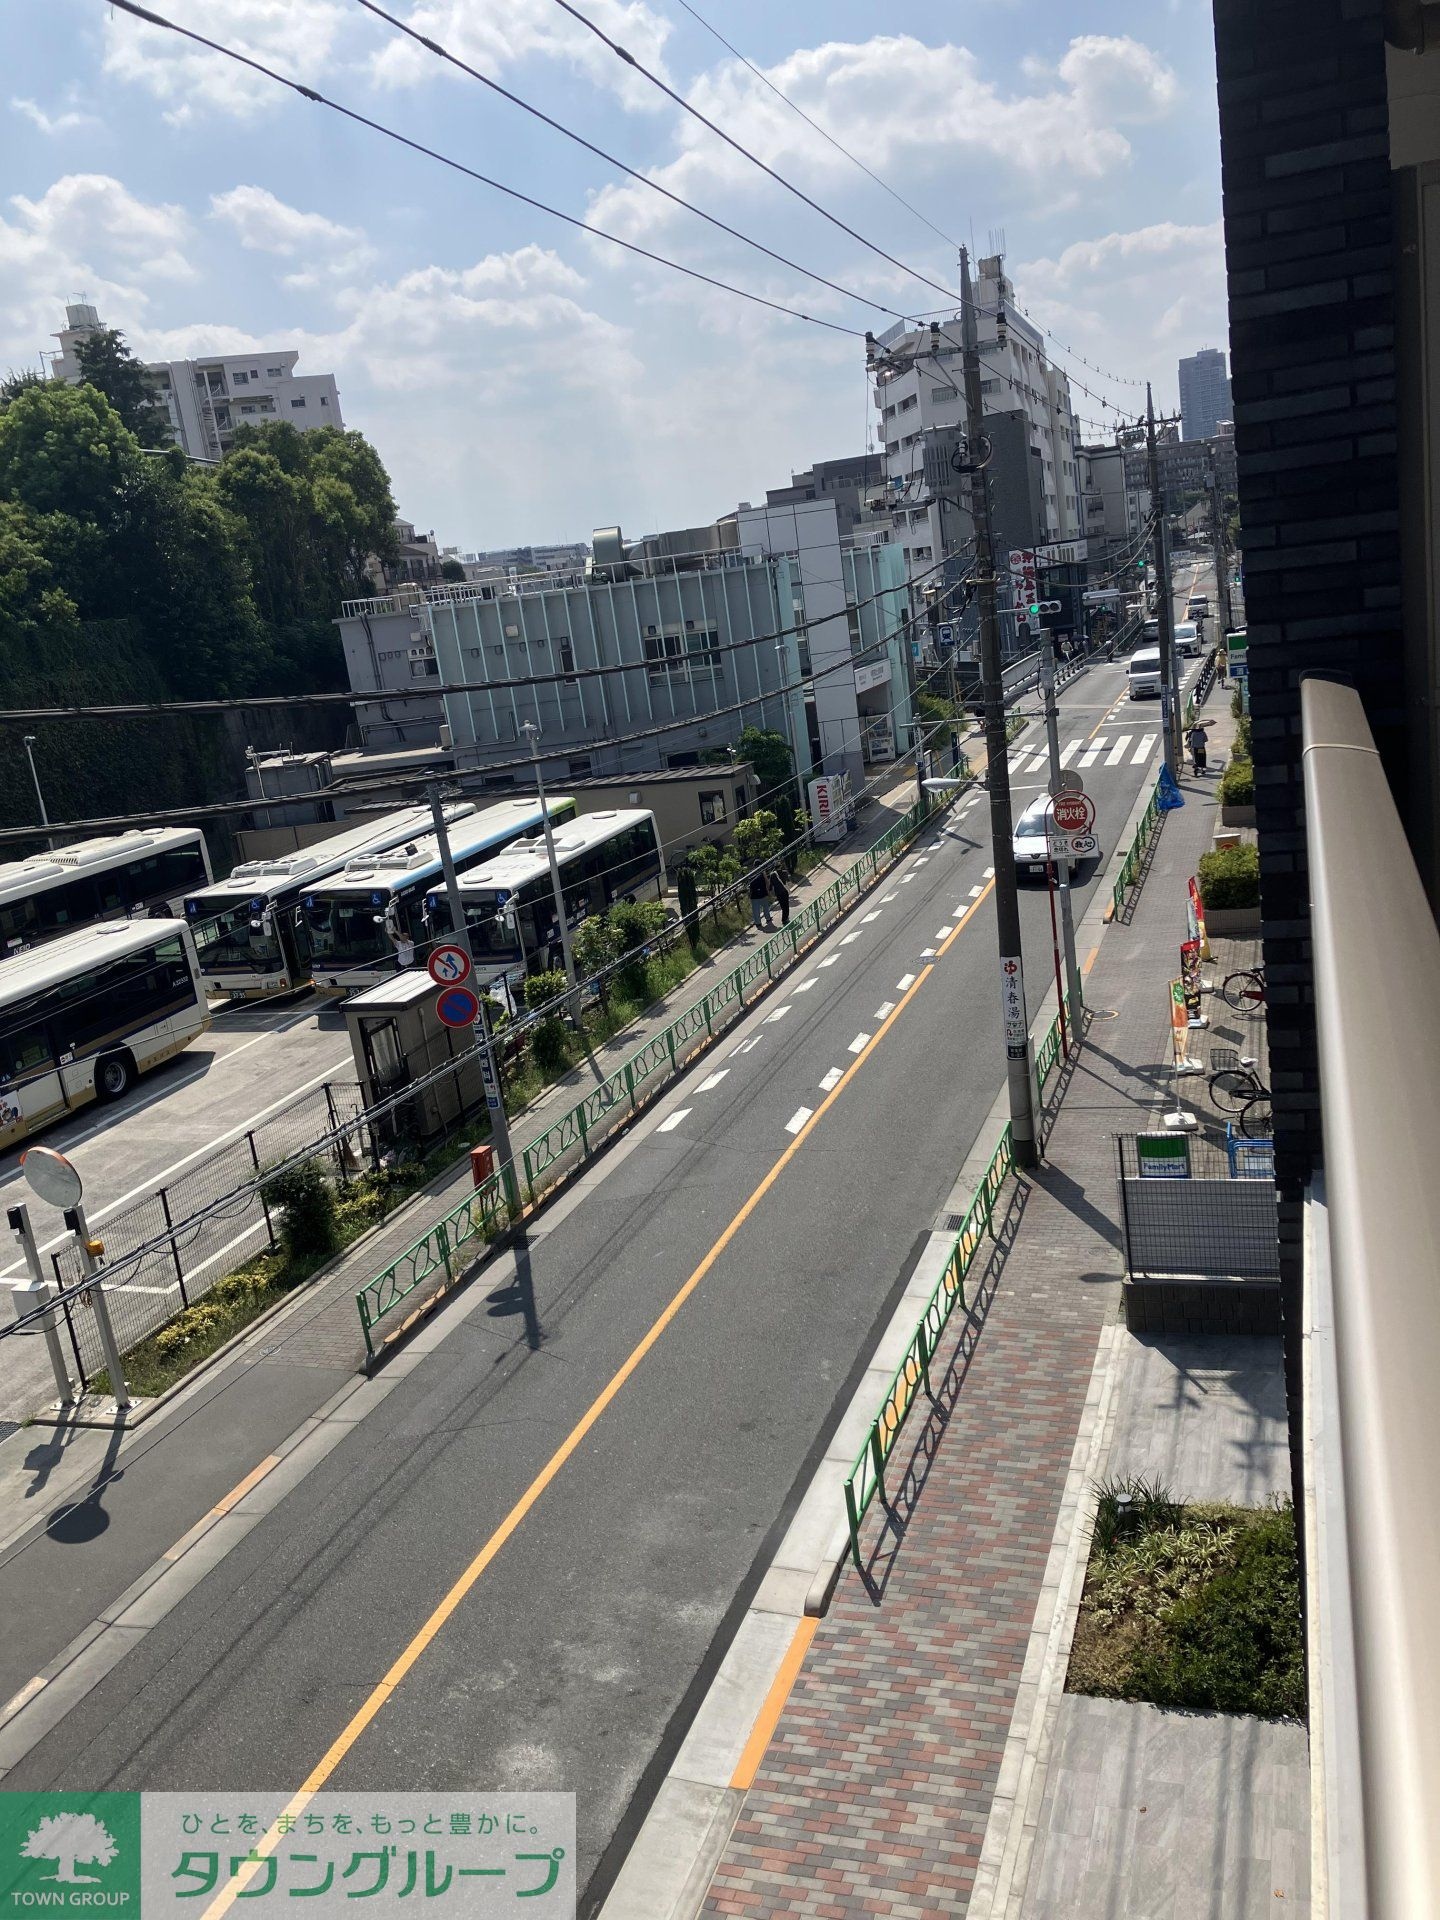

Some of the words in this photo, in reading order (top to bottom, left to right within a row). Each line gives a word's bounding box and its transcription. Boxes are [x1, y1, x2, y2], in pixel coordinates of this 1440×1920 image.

[1056, 806, 1086, 821] 消火栓
[1005, 976, 1020, 1019] 清春湯
[1143, 1162, 1185, 1171] FamilyMart
